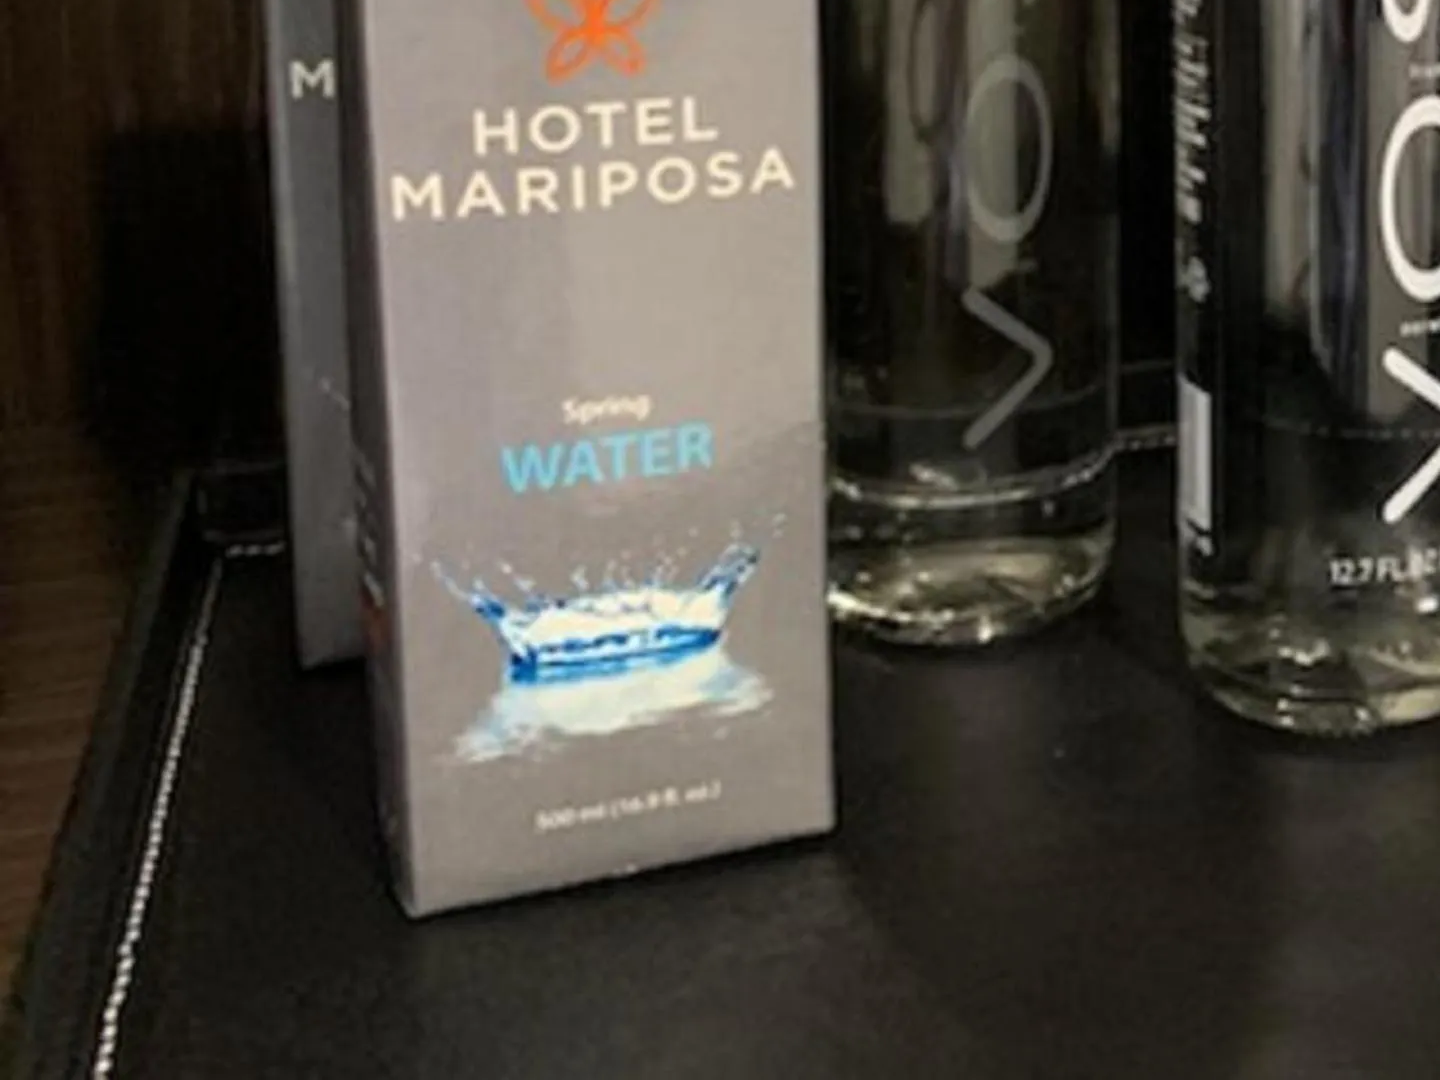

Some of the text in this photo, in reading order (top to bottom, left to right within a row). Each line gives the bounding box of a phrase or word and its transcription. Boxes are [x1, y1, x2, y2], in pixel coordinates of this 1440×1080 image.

[473, 96, 719, 156] HOTEL
[390, 147, 795, 222] MARIPOSA
[560, 394, 652, 425] Spring
[501, 418, 713, 493] WATER
